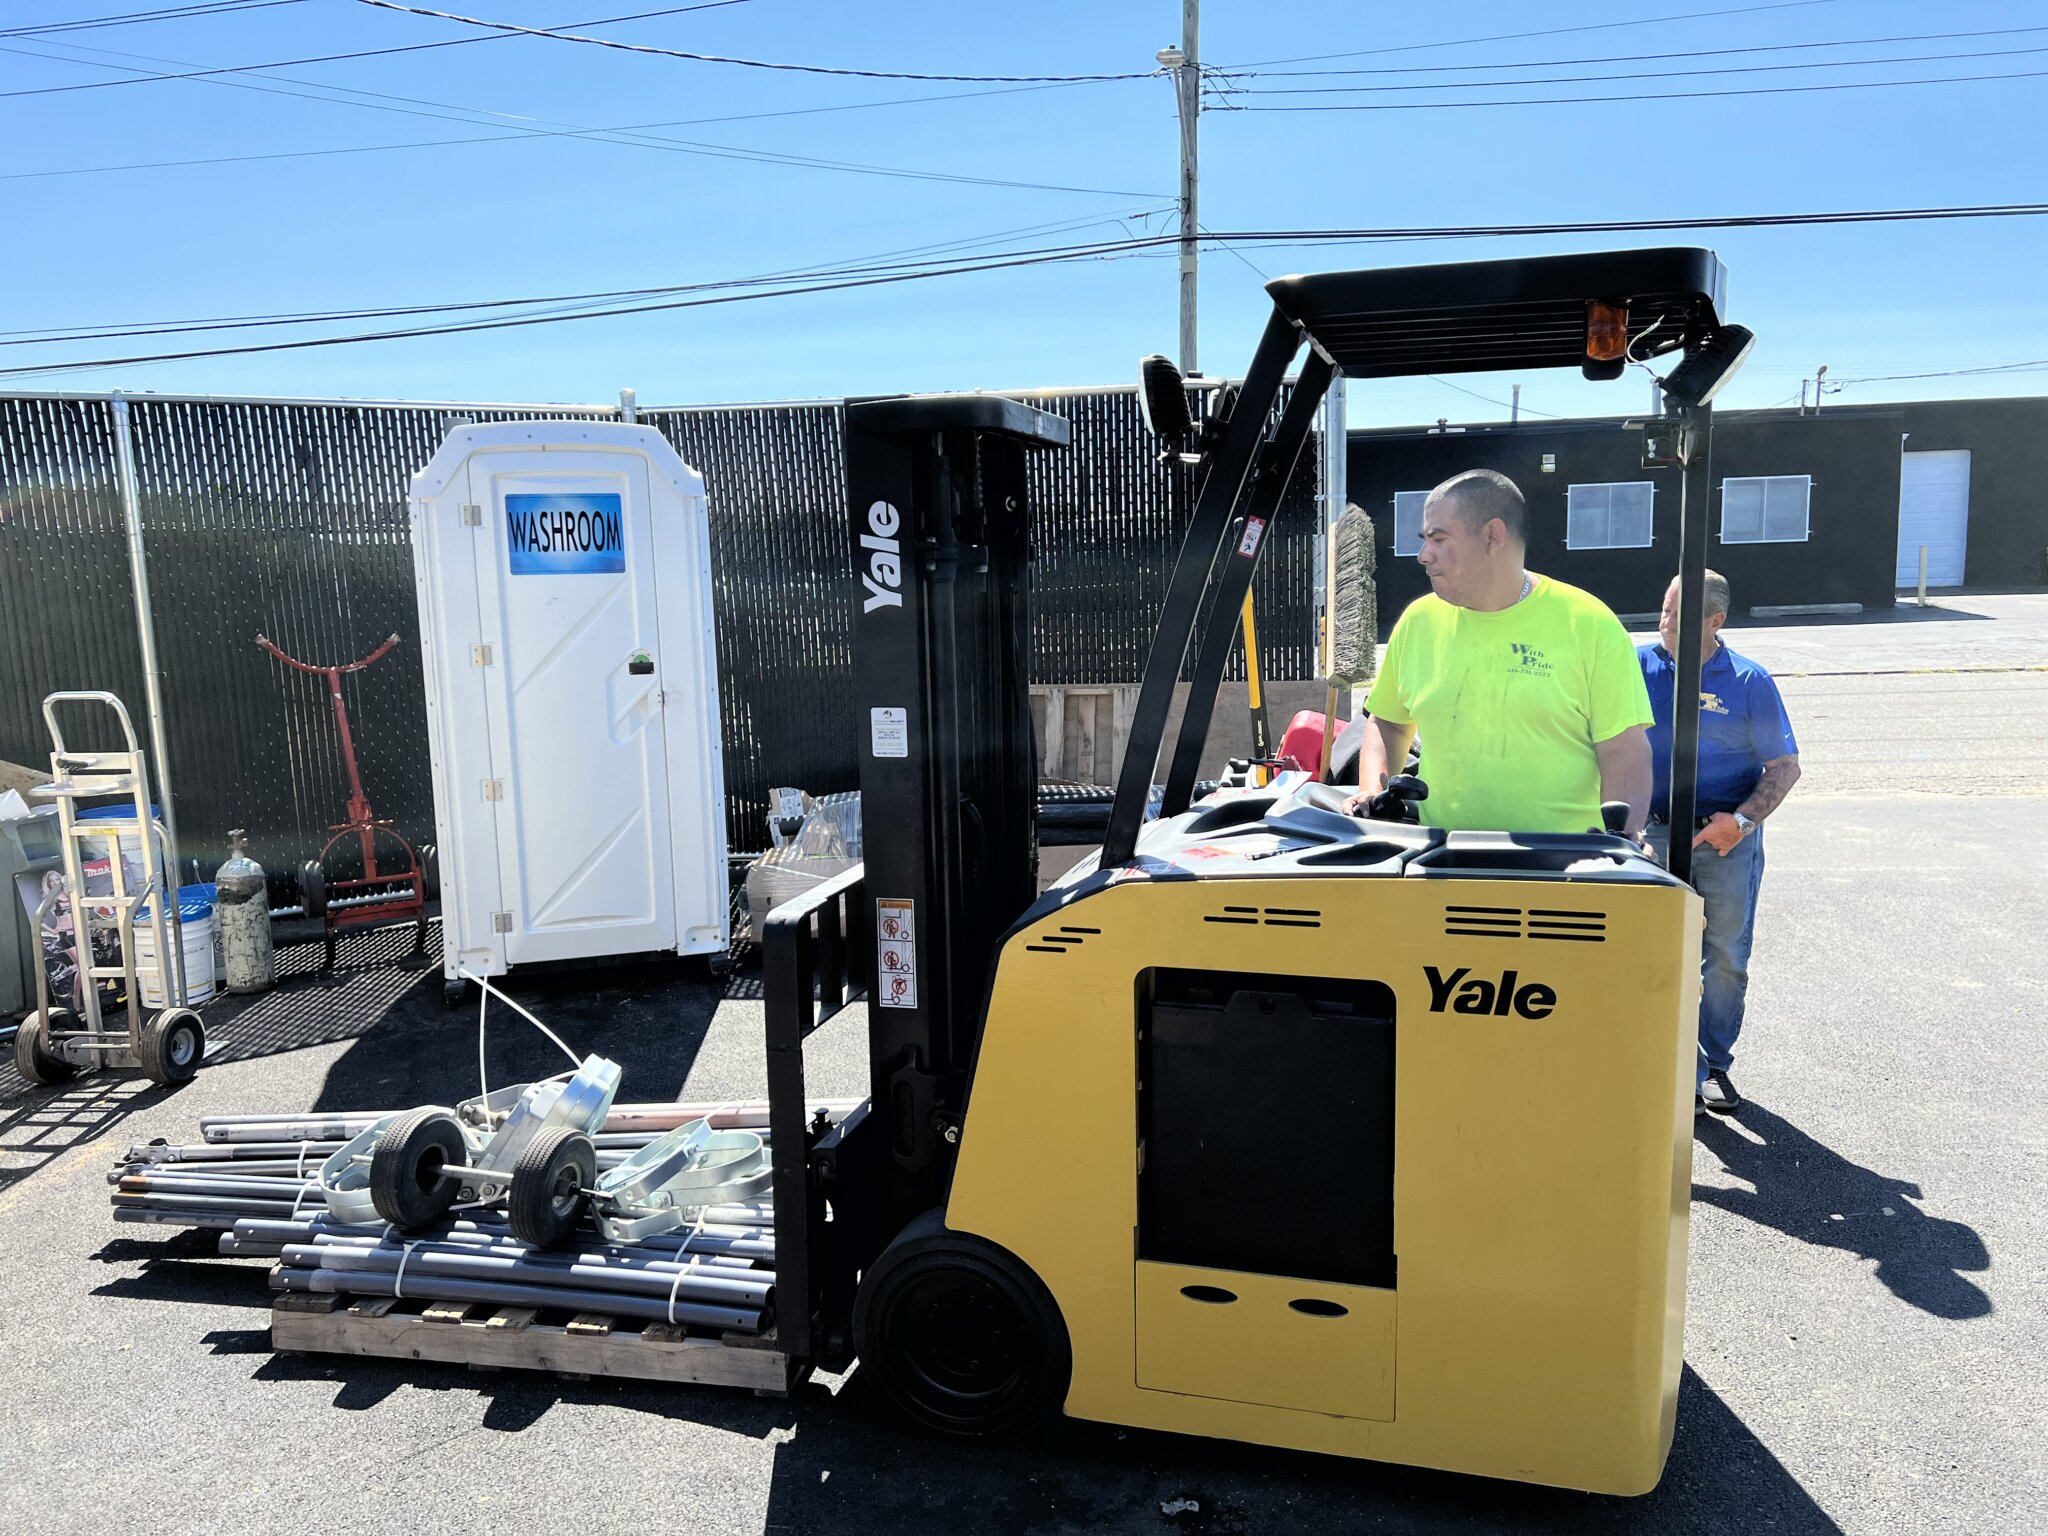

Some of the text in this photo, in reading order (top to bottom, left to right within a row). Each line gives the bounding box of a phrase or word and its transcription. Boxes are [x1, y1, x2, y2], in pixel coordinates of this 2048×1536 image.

[508, 510, 622, 553] WASHROOM
[860, 500, 903, 614] Yale
[1511, 643, 1544, 658] With
[1520, 655, 1554, 669] Pride
[1422, 965, 1557, 1020] Yale
